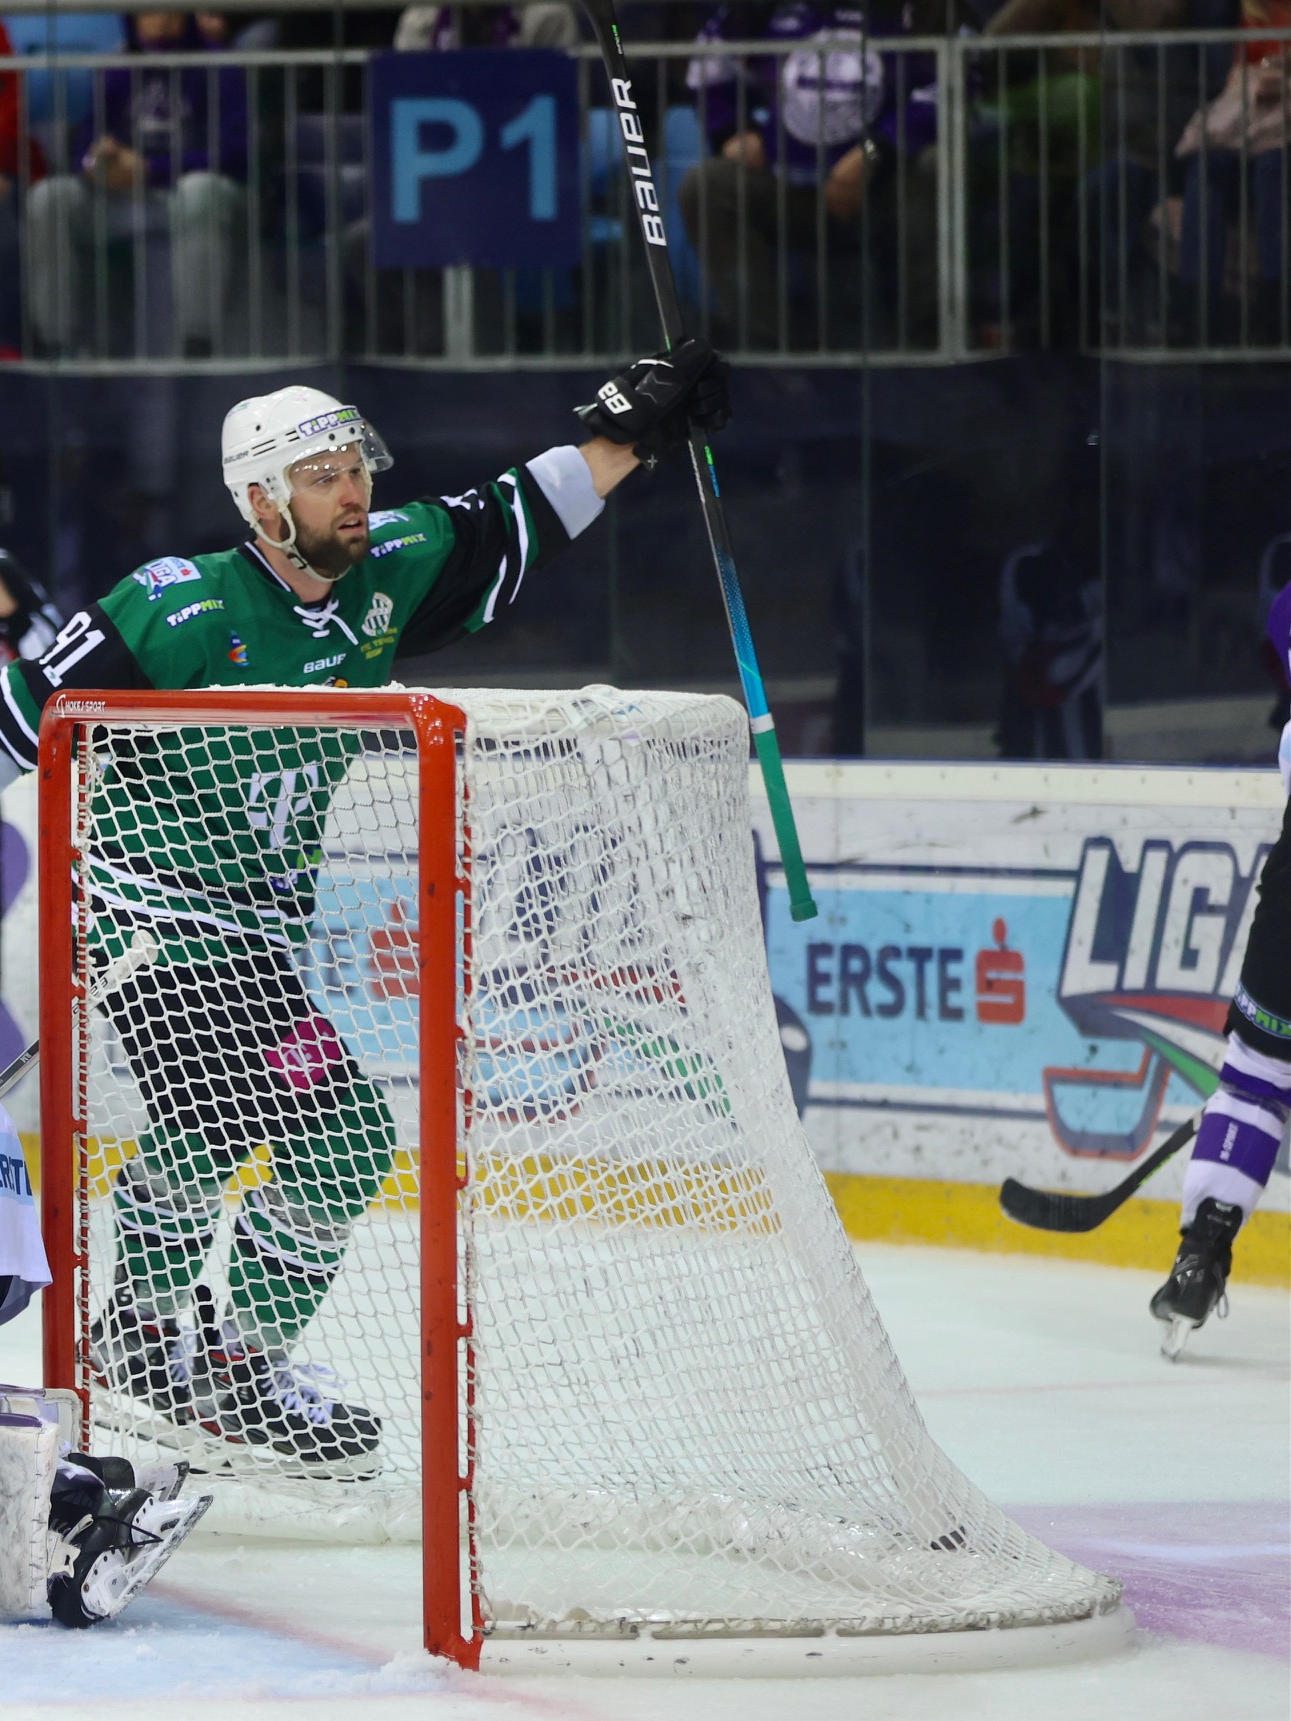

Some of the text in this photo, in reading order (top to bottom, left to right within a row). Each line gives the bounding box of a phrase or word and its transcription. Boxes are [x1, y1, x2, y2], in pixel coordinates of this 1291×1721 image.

[391, 95, 558, 224] P1
[38, 611, 106, 687] 91
[806, 943, 965, 1022] ERSTE
